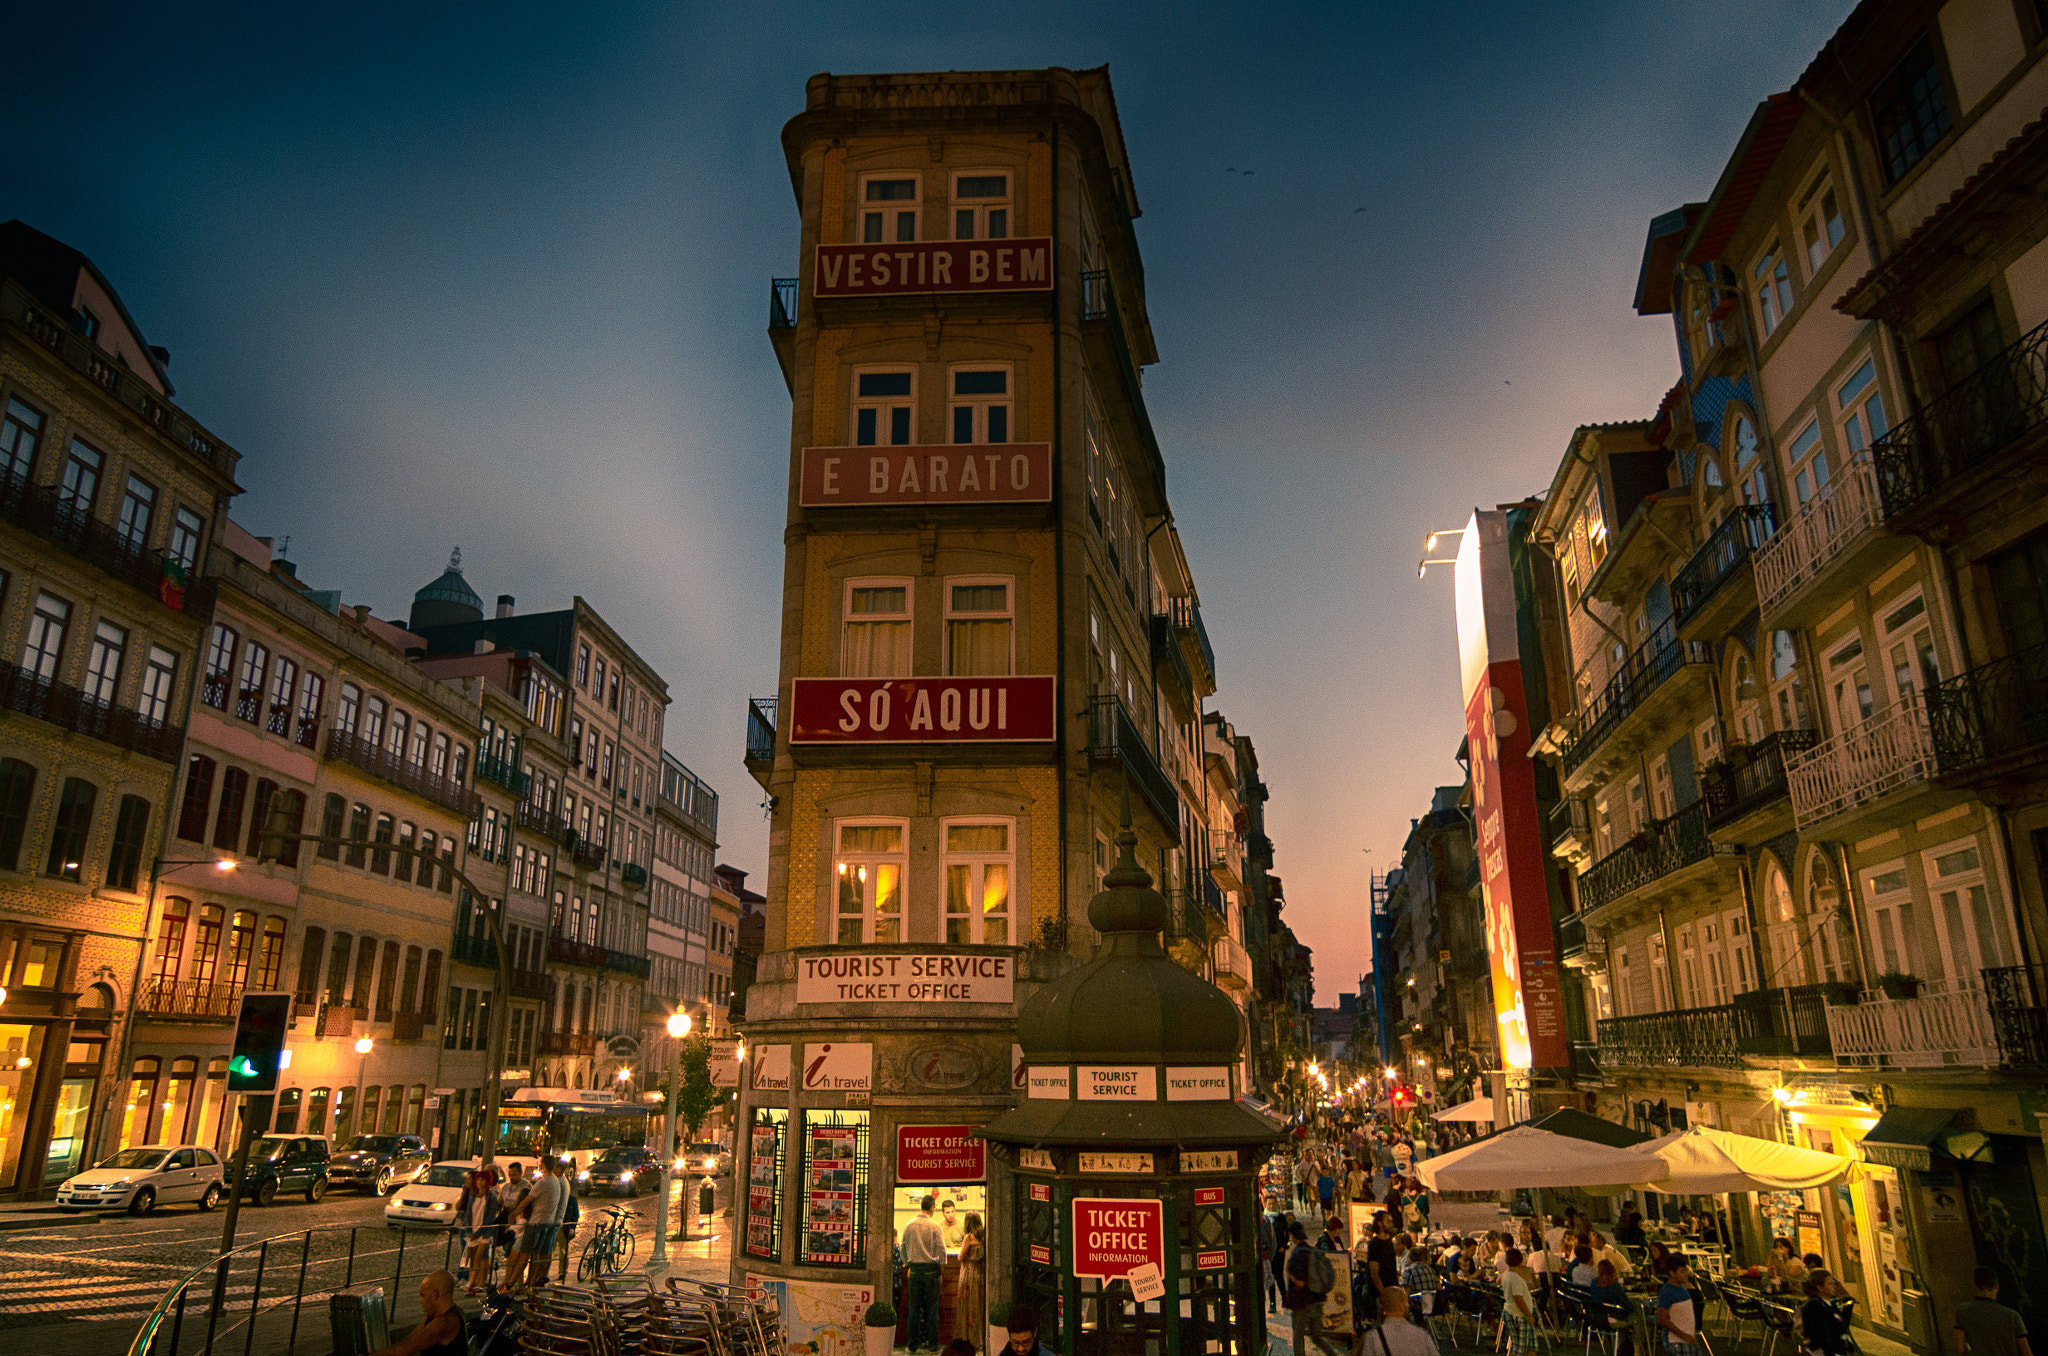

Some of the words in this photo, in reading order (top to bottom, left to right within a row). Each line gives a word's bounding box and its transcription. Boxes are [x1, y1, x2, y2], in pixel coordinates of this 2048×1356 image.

[821, 251, 952, 288] VESTIR
[969, 248, 1046, 283] BEM
[823, 457, 841, 495] E
[869, 454, 1030, 493] BARATO
[838, 681, 893, 733] SÓ
[910, 687, 1007, 732] AQUI
[805, 957, 901, 978] TOURIST
[911, 957, 1006, 978] SERVICE
[837, 984, 900, 999] TICKET
[908, 984, 971, 999] OFFICE
[767, 1076, 788, 1088] travel
[834, 1076, 870, 1088] travel
[1031, 1078, 1048, 1087] TICKET
[1050, 1078, 1067, 1087] OFFICE
[1091, 1071, 1138, 1082] TOURIST
[1170, 1079, 1197, 1088] TICKET
[1200, 1079, 1225, 1088] OFFICE
[1092, 1085, 1137, 1095] SERVICE
[904, 1136, 941, 1148] TICKET
[944, 1136, 980, 1148] OFFICE
[907, 1159, 943, 1169] TOURIST
[944, 1158, 976, 1168] SERVICE
[1203, 1191, 1216, 1200] BUS
[1088, 1210, 1147, 1228] TICKET
[1088, 1231, 1148, 1250] OFFICE
[1031, 1248, 1049, 1260] CRUISES
[1088, 1252, 1149, 1264] INFORMATION
[1199, 1254, 1224, 1266] CRUISES
[1134, 1274, 1157, 1286] TOURIST
[1136, 1284, 1159, 1295] SERVICE
